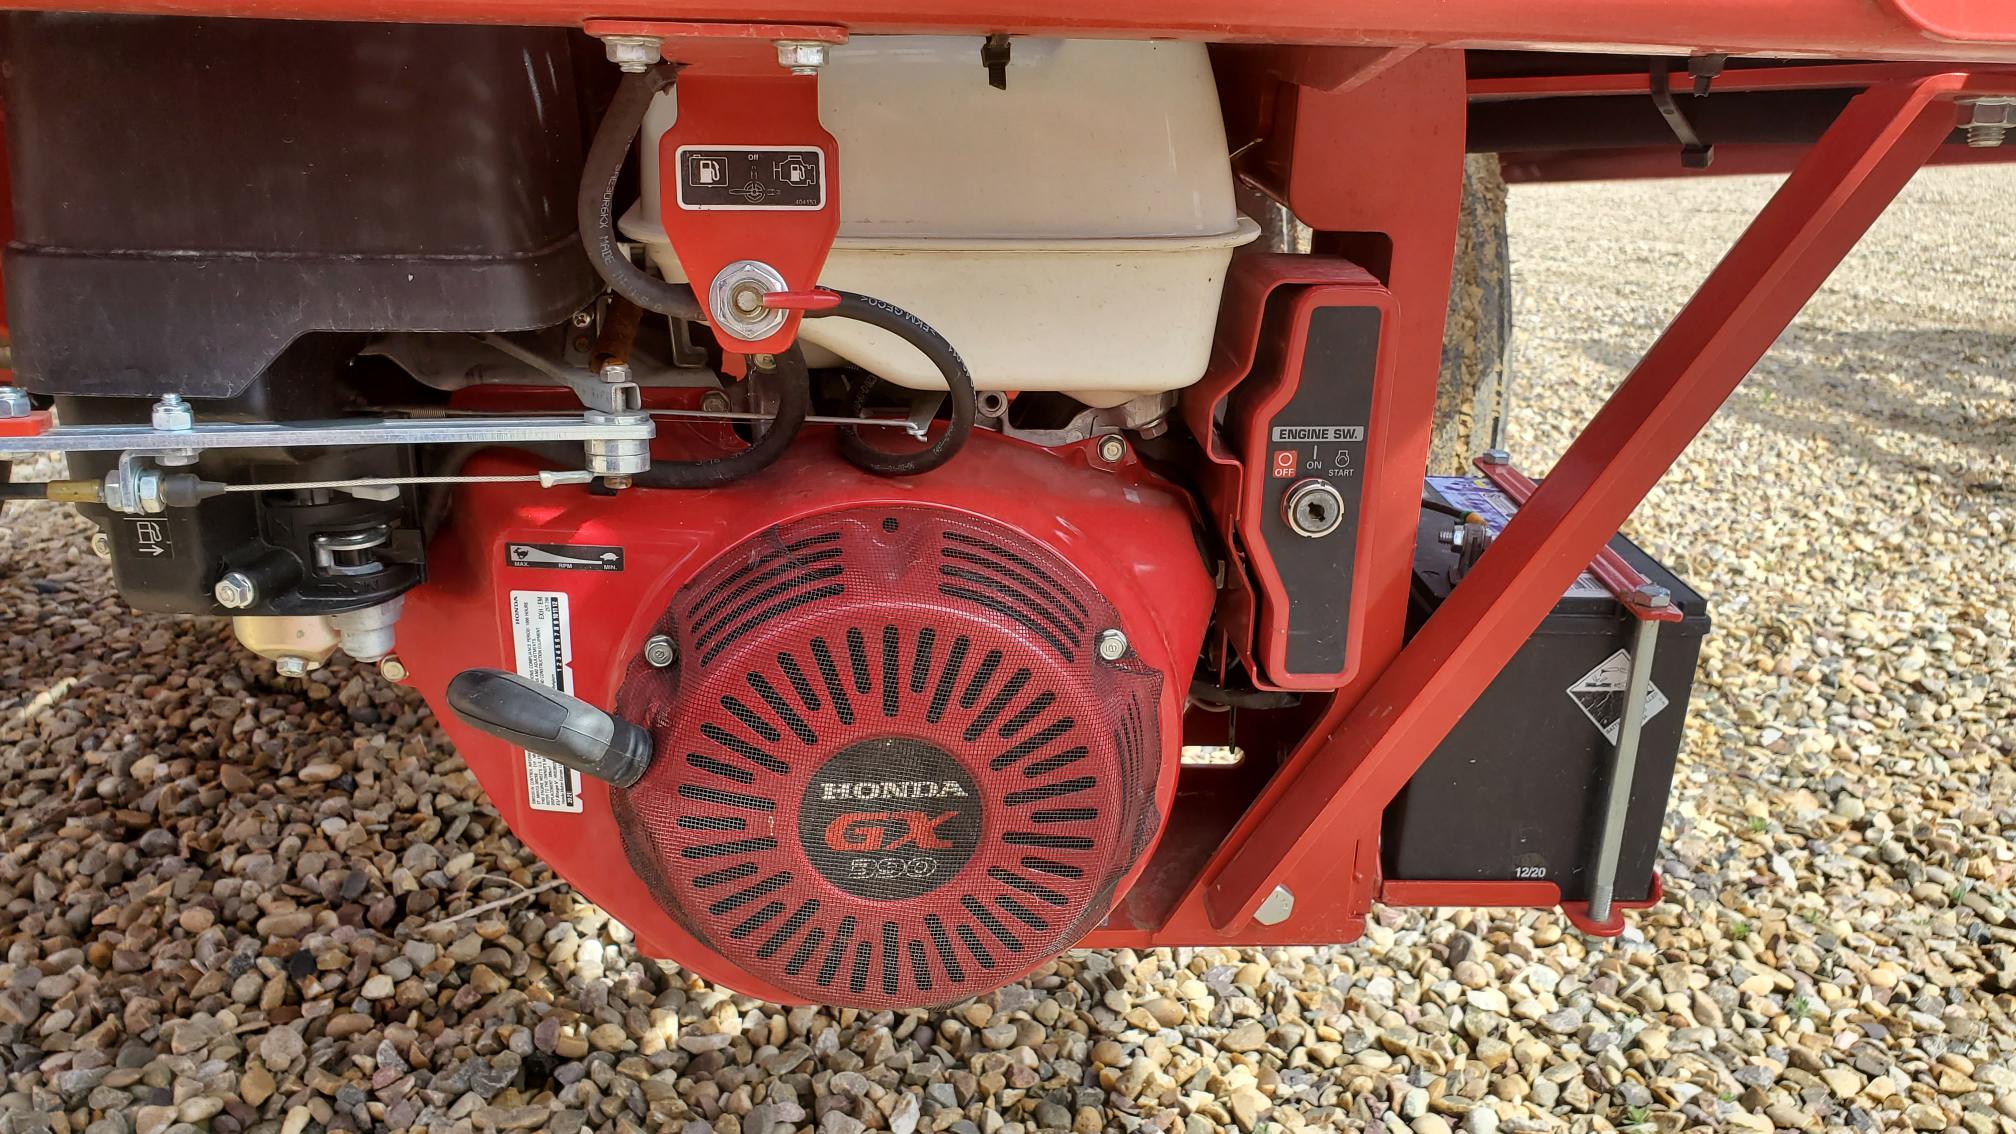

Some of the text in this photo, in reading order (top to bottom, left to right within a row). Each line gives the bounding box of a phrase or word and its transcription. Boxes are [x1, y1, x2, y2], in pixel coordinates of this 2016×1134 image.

[600, 235, 616, 266] MADE
[1280, 428, 1357, 439] ENGINE SW.
[1275, 468, 1296, 477] OFF
[1306, 461, 1322, 469] ON
[820, 781, 969, 800] HONDA
[825, 811, 959, 852] GX
[849, 858, 937, 878] 390
[1515, 866, 1547, 878] 12/20
